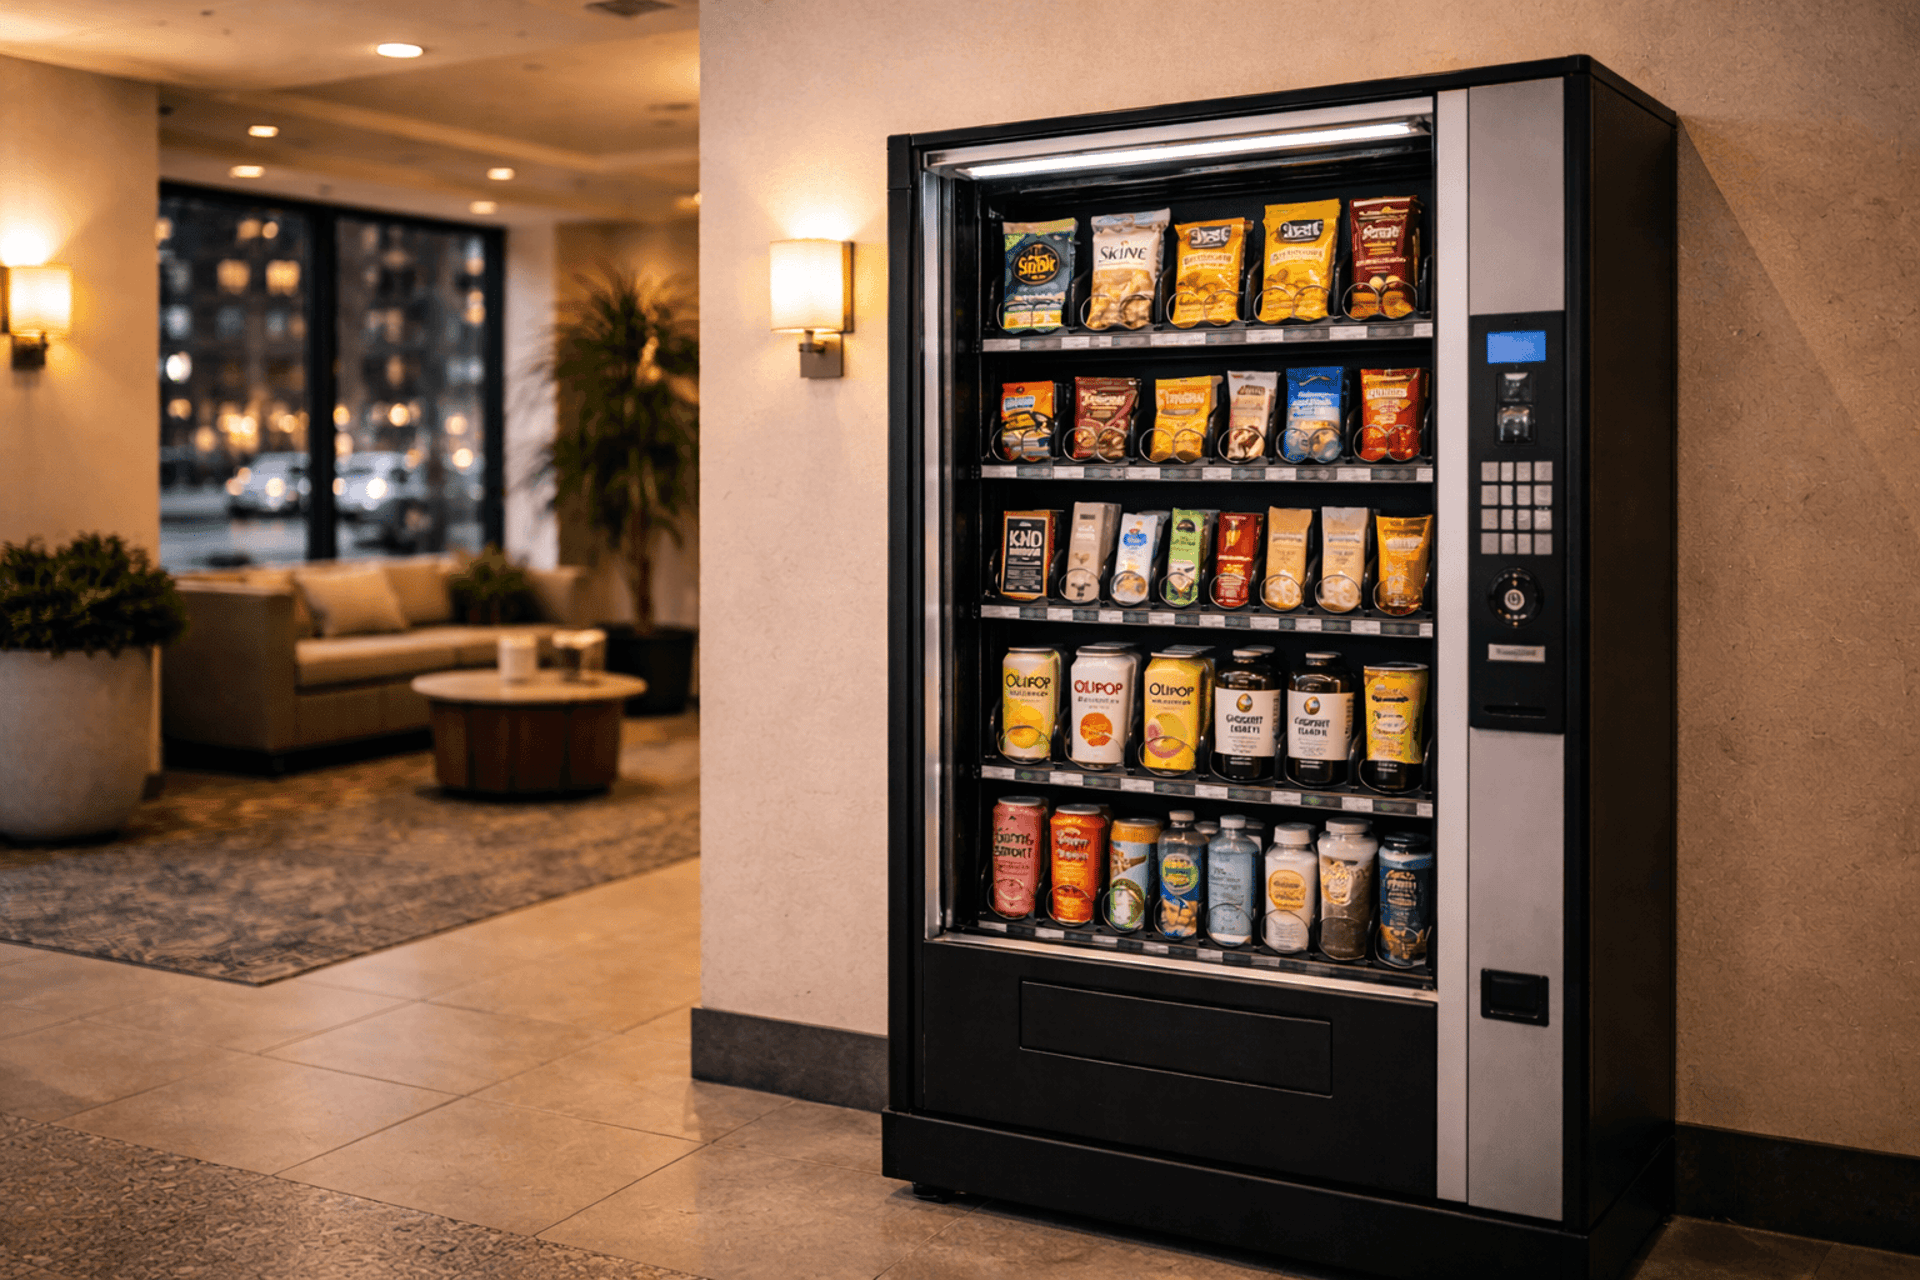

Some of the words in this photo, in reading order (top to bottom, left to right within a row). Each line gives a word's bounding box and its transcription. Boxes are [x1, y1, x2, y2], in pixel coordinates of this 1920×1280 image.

[1098, 245, 1148, 262] SKINE
[1073, 679, 1123, 696] OLIPOP
[1149, 681, 1196, 698] OLIPOP
